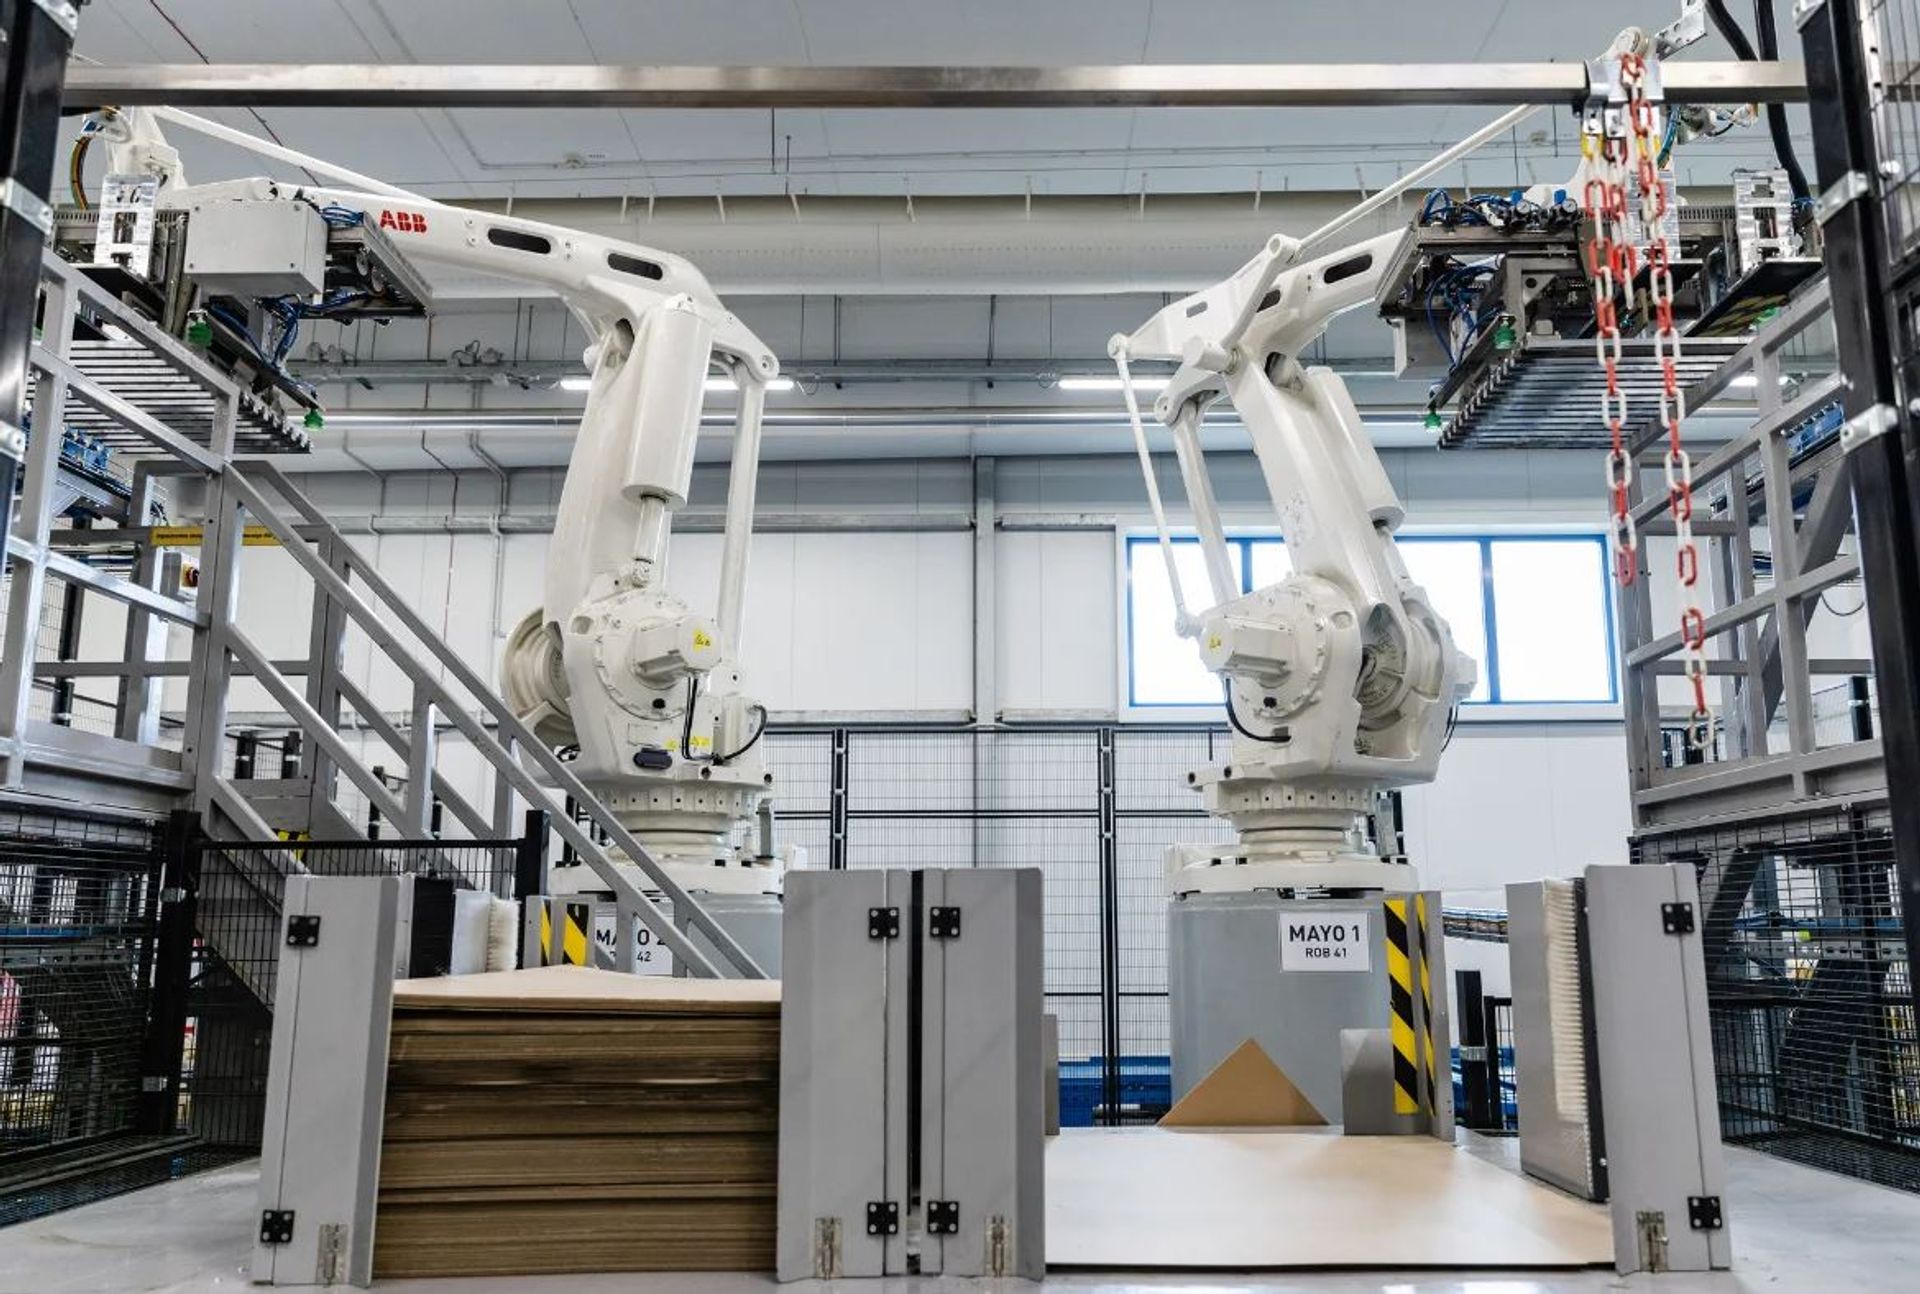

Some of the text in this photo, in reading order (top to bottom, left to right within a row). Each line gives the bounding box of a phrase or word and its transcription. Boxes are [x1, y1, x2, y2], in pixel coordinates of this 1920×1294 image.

[380, 210, 427, 233] ABB
[596, 929, 650, 946] MO
[1289, 925, 1360, 942] MAYO 1
[637, 951, 651, 962] 42
[1305, 947, 1347, 958] ROB 41
